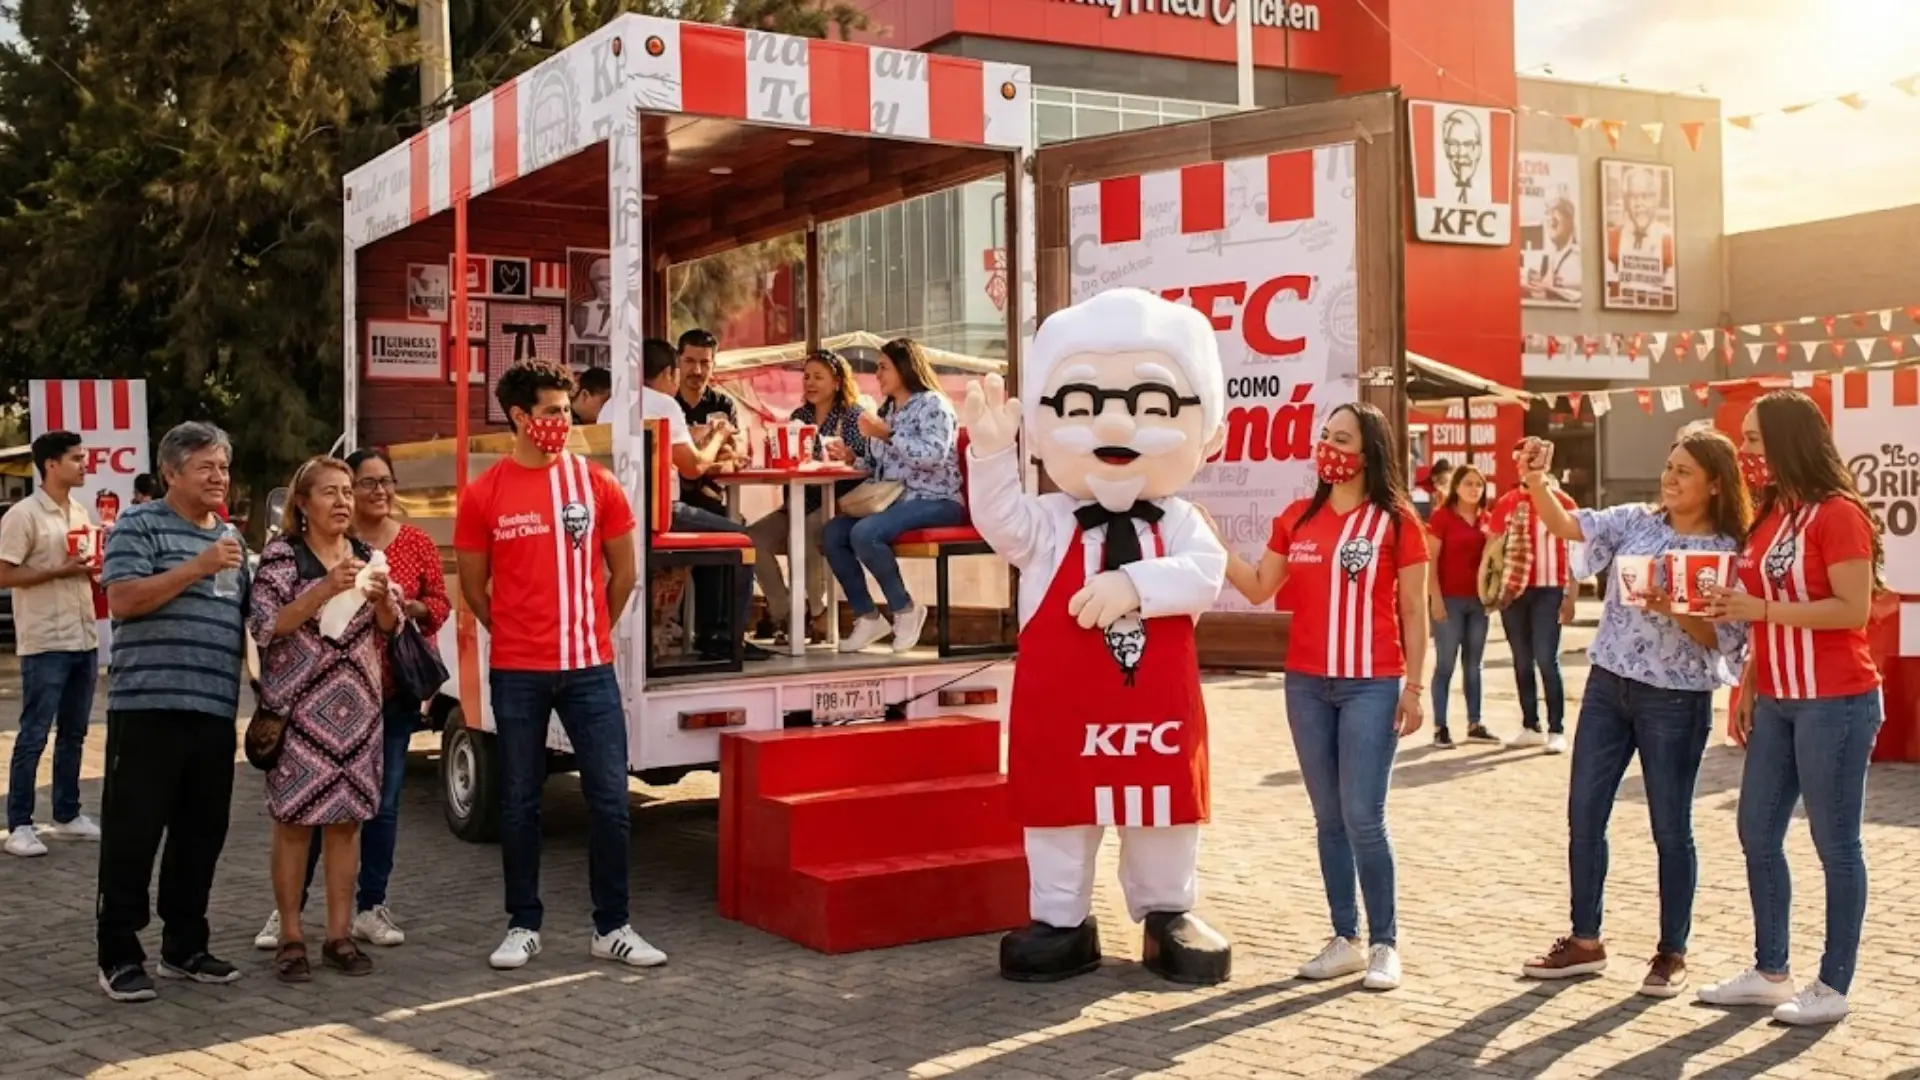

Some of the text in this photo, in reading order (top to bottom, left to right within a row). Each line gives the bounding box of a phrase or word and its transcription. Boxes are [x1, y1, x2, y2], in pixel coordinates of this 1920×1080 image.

[1212, 0, 1319, 31] Cicken
[1431, 207, 1497, 238] KFC
[1161, 275, 1311, 356] FC
[1227, 375, 1280, 398] COMO
[1206, 383, 1315, 463] ná
[84, 447, 137, 475] FC
[1080, 721, 1183, 756] KFC
